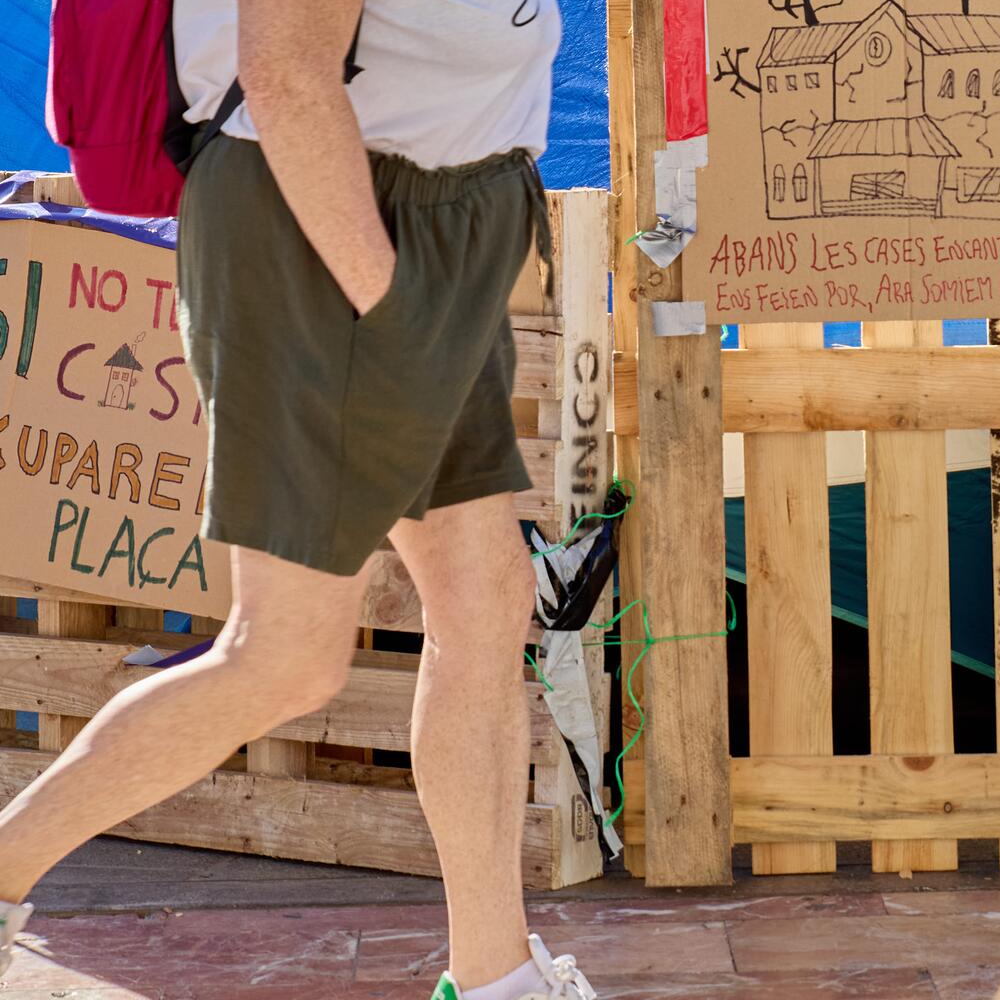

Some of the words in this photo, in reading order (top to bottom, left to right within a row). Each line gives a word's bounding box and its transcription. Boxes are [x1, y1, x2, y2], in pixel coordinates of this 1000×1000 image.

[709, 231, 799, 277] ABANS
[810, 233, 857, 272] LES
[864, 236, 926, 267] CASES
[68, 262, 128, 313] NO
[716, 281, 751, 312] ENS
[824, 279, 873, 314] POR,
[875, 273, 914, 305] ARA
[0, 414, 210, 517] UPARE
[48, 497, 209, 593] PLAÇA
